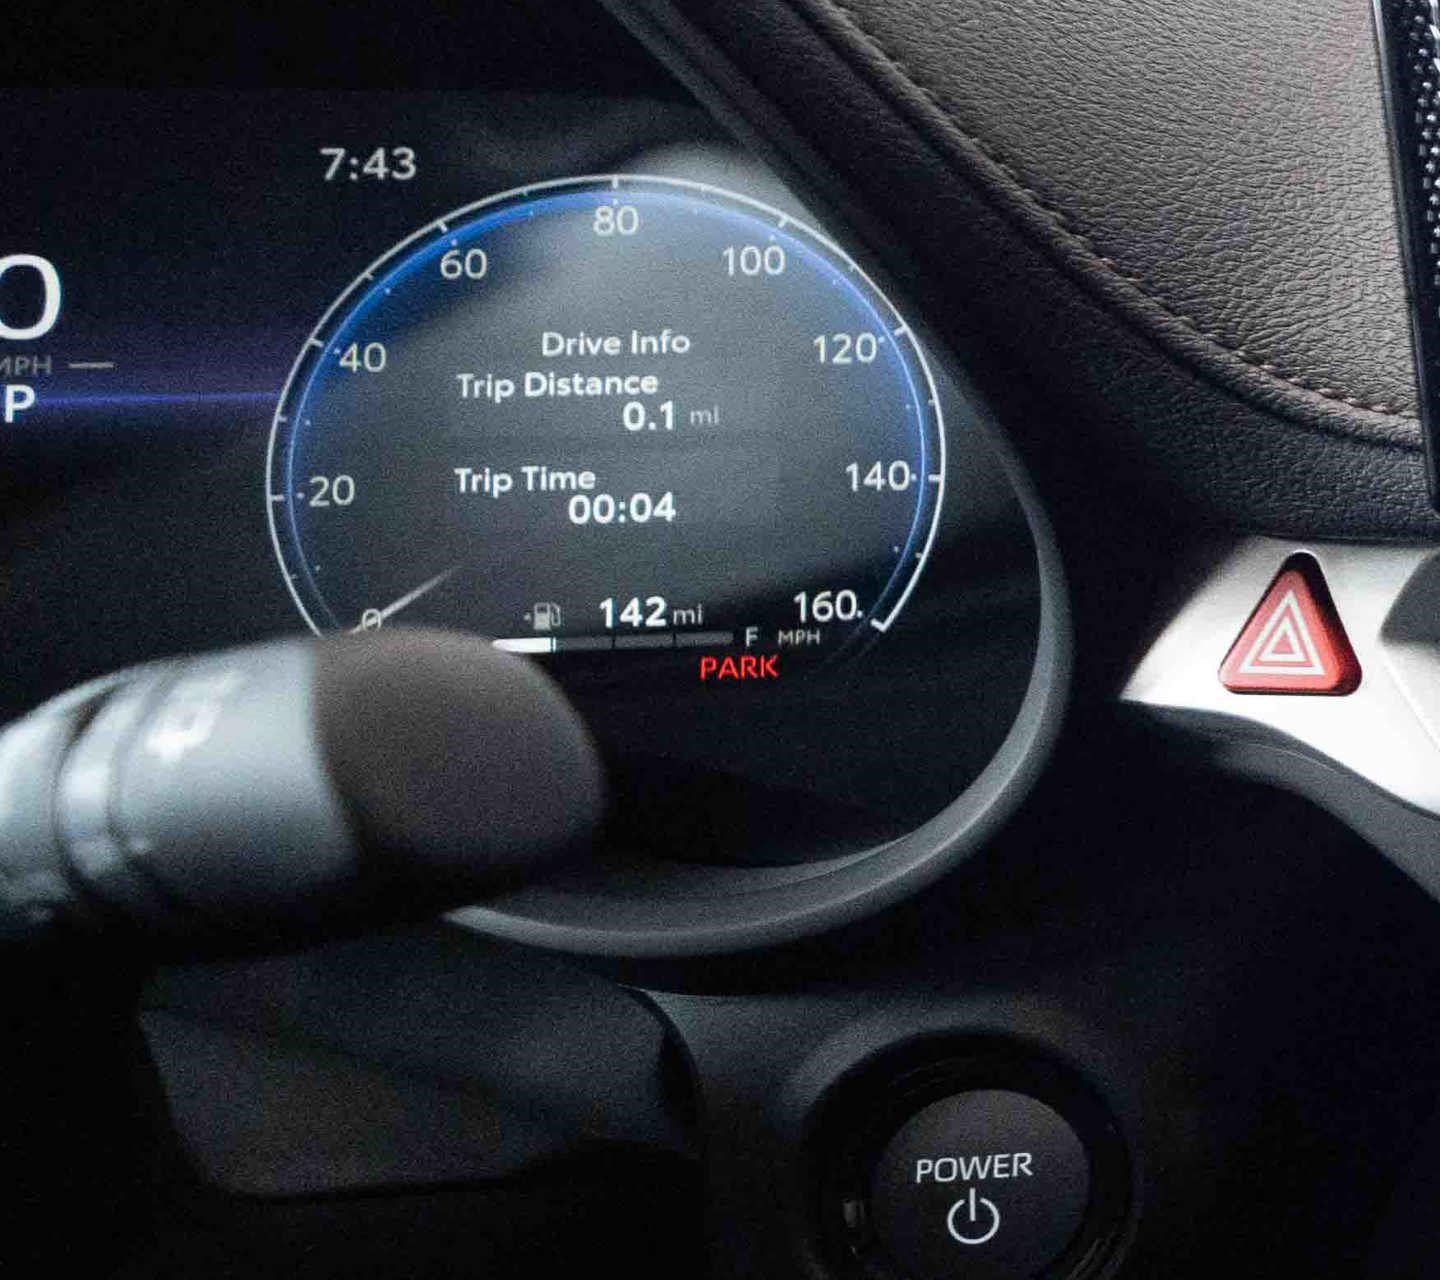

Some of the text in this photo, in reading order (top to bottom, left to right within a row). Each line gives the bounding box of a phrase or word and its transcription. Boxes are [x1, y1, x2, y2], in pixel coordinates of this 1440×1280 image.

[320, 147, 416, 180] 7:43
[593, 204, 639, 236] 80
[439, 249, 488, 280] 60
[721, 246, 786, 278] 100
[339, 342, 387, 372] 40
[542, 328, 692, 357] Drive Info
[812, 333, 878, 365] 120
[456, 369, 660, 402] Trip Distance
[5, 384, 36, 423] P
[622, 403, 719, 431] 0.1 mi
[309, 475, 356, 506] 20
[454, 466, 597, 496] Trip Time
[846, 462, 911, 492] 140
[567, 494, 677, 525] 00:04
[598, 596, 704, 627] 142 mi
[793, 590, 857, 621] 160
[745, 627, 759, 647] F
[777, 628, 822, 646] MPH
[699, 655, 780, 681] PARK
[916, 1152, 1033, 1183] POWER
